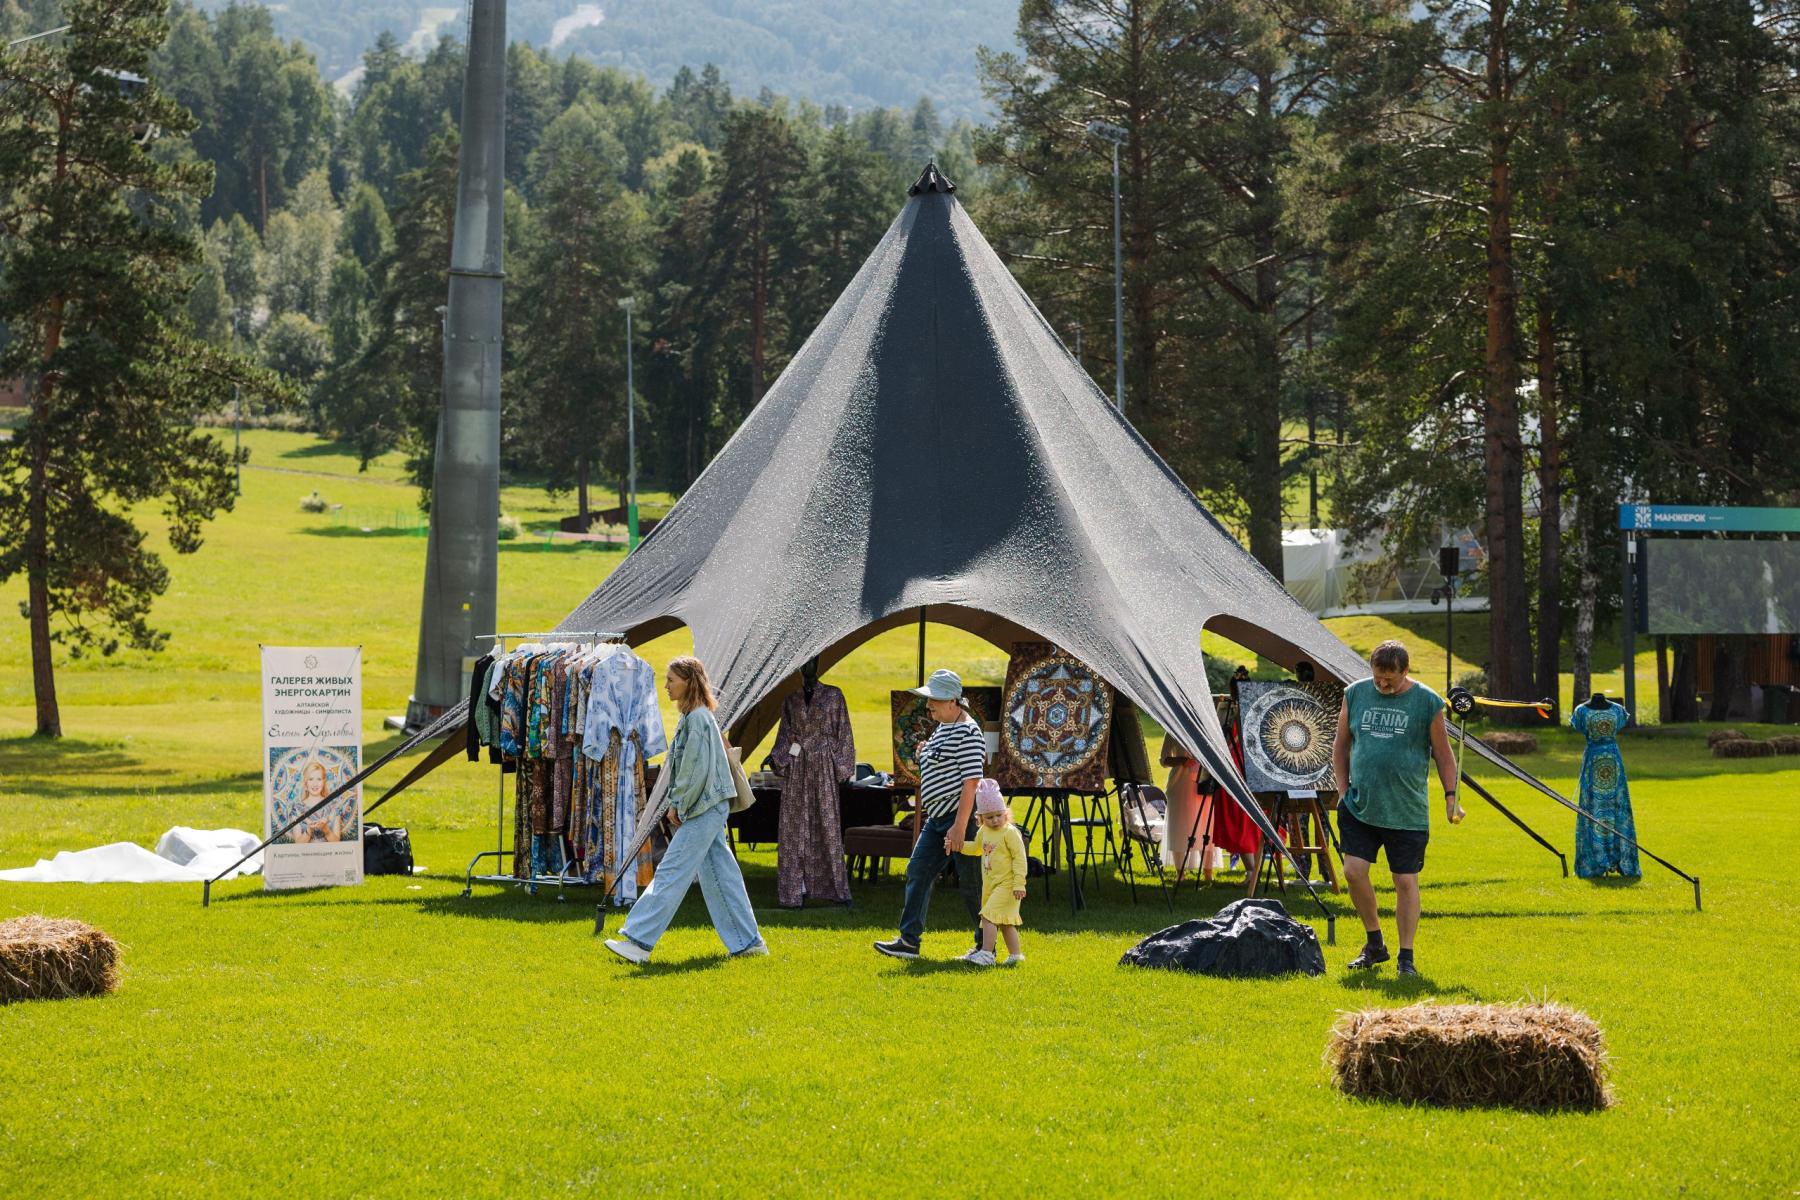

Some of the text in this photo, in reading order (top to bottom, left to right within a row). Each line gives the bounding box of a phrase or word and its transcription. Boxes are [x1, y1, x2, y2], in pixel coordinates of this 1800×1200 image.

[1654, 513, 1706, 522] МАНЖЕРОК
[271, 676, 353, 685] ГАЛЕРЕЯ ЖИВЫХ
[274, 688, 351, 697] ЭНЕРГОКАРТИН
[1361, 710, 1409, 729] DENIM
